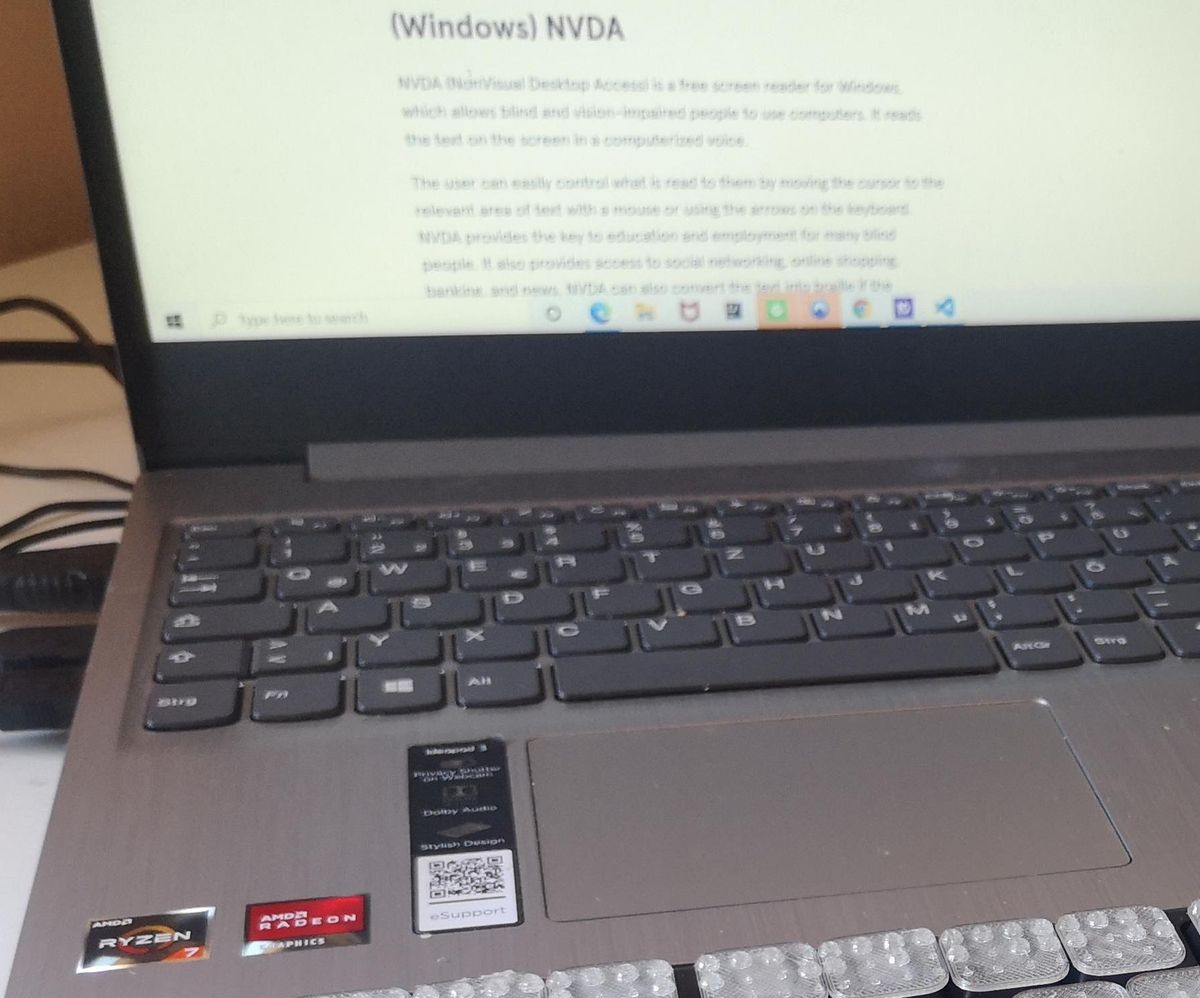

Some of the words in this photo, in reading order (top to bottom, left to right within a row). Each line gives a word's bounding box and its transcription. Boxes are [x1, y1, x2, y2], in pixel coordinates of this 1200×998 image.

[391, 13, 536, 41] (Windows)
[547, 15, 625, 41] NVDA
[399, 77, 441, 91] NVDA
[446, 77, 524, 92] (NonVisual
[530, 77, 589, 93] Desktop
[595, 77, 648, 92] Access)
[652, 78, 664, 92] is
[668, 81, 675, 92] a
[680, 79, 708, 92] free
[712, 81, 759, 93] screen
[763, 80, 810, 92] reader
[814, 80, 833, 93] for
[402, 105, 446, 119] which
[451, 106, 497, 119] allows
[502, 106, 537, 120] blind
[543, 106, 569, 120] and
[574, 106, 686, 122] vision-impaired
[690, 108, 739, 123] people
[743, 108, 758, 120] to
[762, 110, 785, 121] use
[871, 107, 880, 120] It
[886, 108, 922, 122] reads
[405, 133, 430, 147] the
[434, 134, 463, 147] text
[469, 136, 486, 147] on
[490, 133, 515, 147] the
[520, 135, 569, 147] screen
[575, 134, 587, 147] in
[592, 136, 600, 146] a
[604, 133, 703, 149] computerized
[411, 176, 440, 190] The
[445, 179, 474, 190] user
[480, 179, 508, 190] can
[512, 177, 552, 191] easily
[556, 176, 608, 190] control
[613, 177, 646, 190] what
[651, 177, 661, 190] is
[666, 177, 697, 190] read
[700, 177, 715, 190] to
[719, 177, 755, 190] them
[760, 177, 776, 192] by
[781, 177, 829, 192] moving
[832, 177, 853, 190] the
[858, 179, 900, 190] cursor
[904, 178, 919, 190] to
[922, 178, 944, 190] the
[416, 204, 474, 217] relevant
[480, 206, 512, 217] area
[516, 204, 530, 217] of
[535, 204, 562, 217] text
[567, 204, 596, 217] with
[600, 207, 609, 216] a
[614, 206, 660, 217] mouse
[664, 207, 678, 217] or
[684, 205, 720, 218] using
[724, 204, 746, 216] the
[751, 205, 796, 216] arrows
[801, 206, 817, 216] on
[821, 204, 843, 216] the
[419, 231, 461, 244] NVDA
[466, 231, 528, 245] provides
[532, 231, 556, 243] the
[560, 231, 583, 244] key
[588, 231, 602, 243] to
[607, 231, 678, 243] education
[682, 230, 708, 242] and
[712, 230, 796, 244] employment
[801, 230, 819, 242] for
[824, 231, 860, 243] many
[863, 229, 896, 242] blind
[423, 807, 458, 818] Dolby
[462, 804, 498, 814] Audio
[420, 841, 461, 852] Stylish
[463, 838, 505, 848] Design
[261, 912, 295, 923] AMD
[430, 906, 507, 920] eSupport
[92, 918, 124, 929] AMD
[258, 913, 357, 930] RADEON
[98, 930, 191, 950] RYZEN
[260, 937, 326, 950] APHICS
[183, 947, 200, 958] 7
